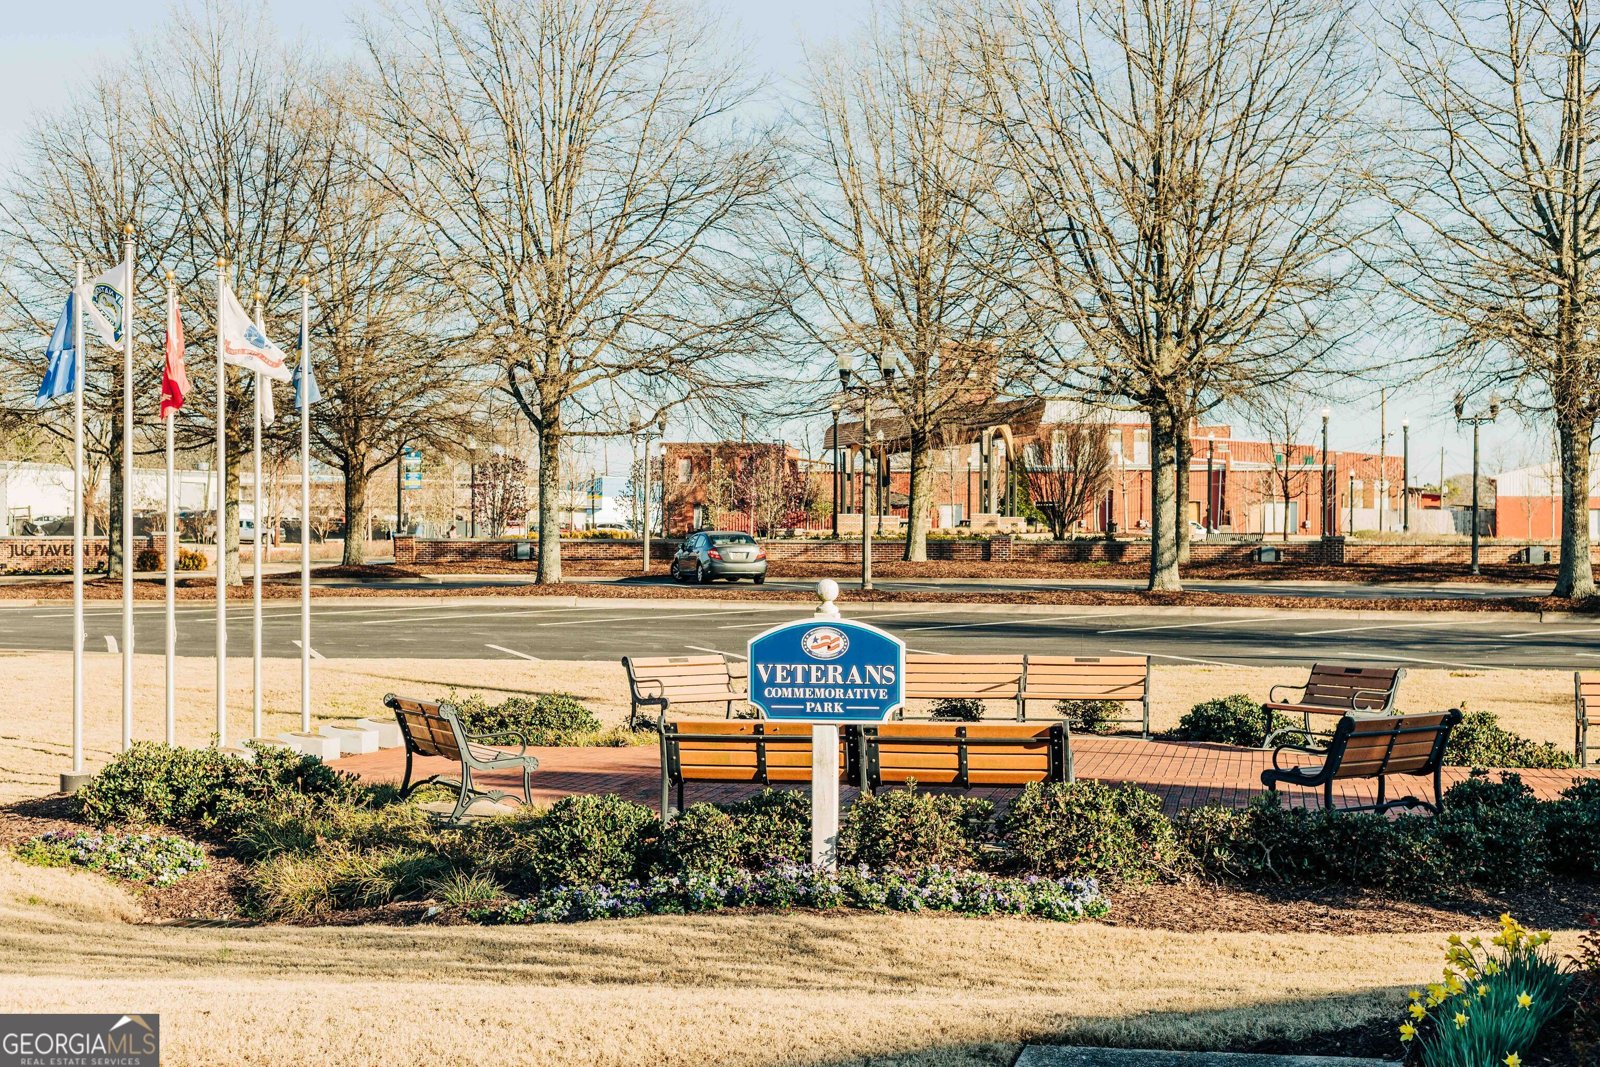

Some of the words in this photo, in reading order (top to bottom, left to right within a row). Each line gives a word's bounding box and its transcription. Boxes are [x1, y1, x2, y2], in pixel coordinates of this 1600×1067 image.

[8, 544, 35, 558] JUG
[94, 544, 109, 556] PA
[756, 663, 896, 685] VETERANS
[764, 687, 888, 700] COMMEMORATIVE
[806, 702, 845, 713] PARK
